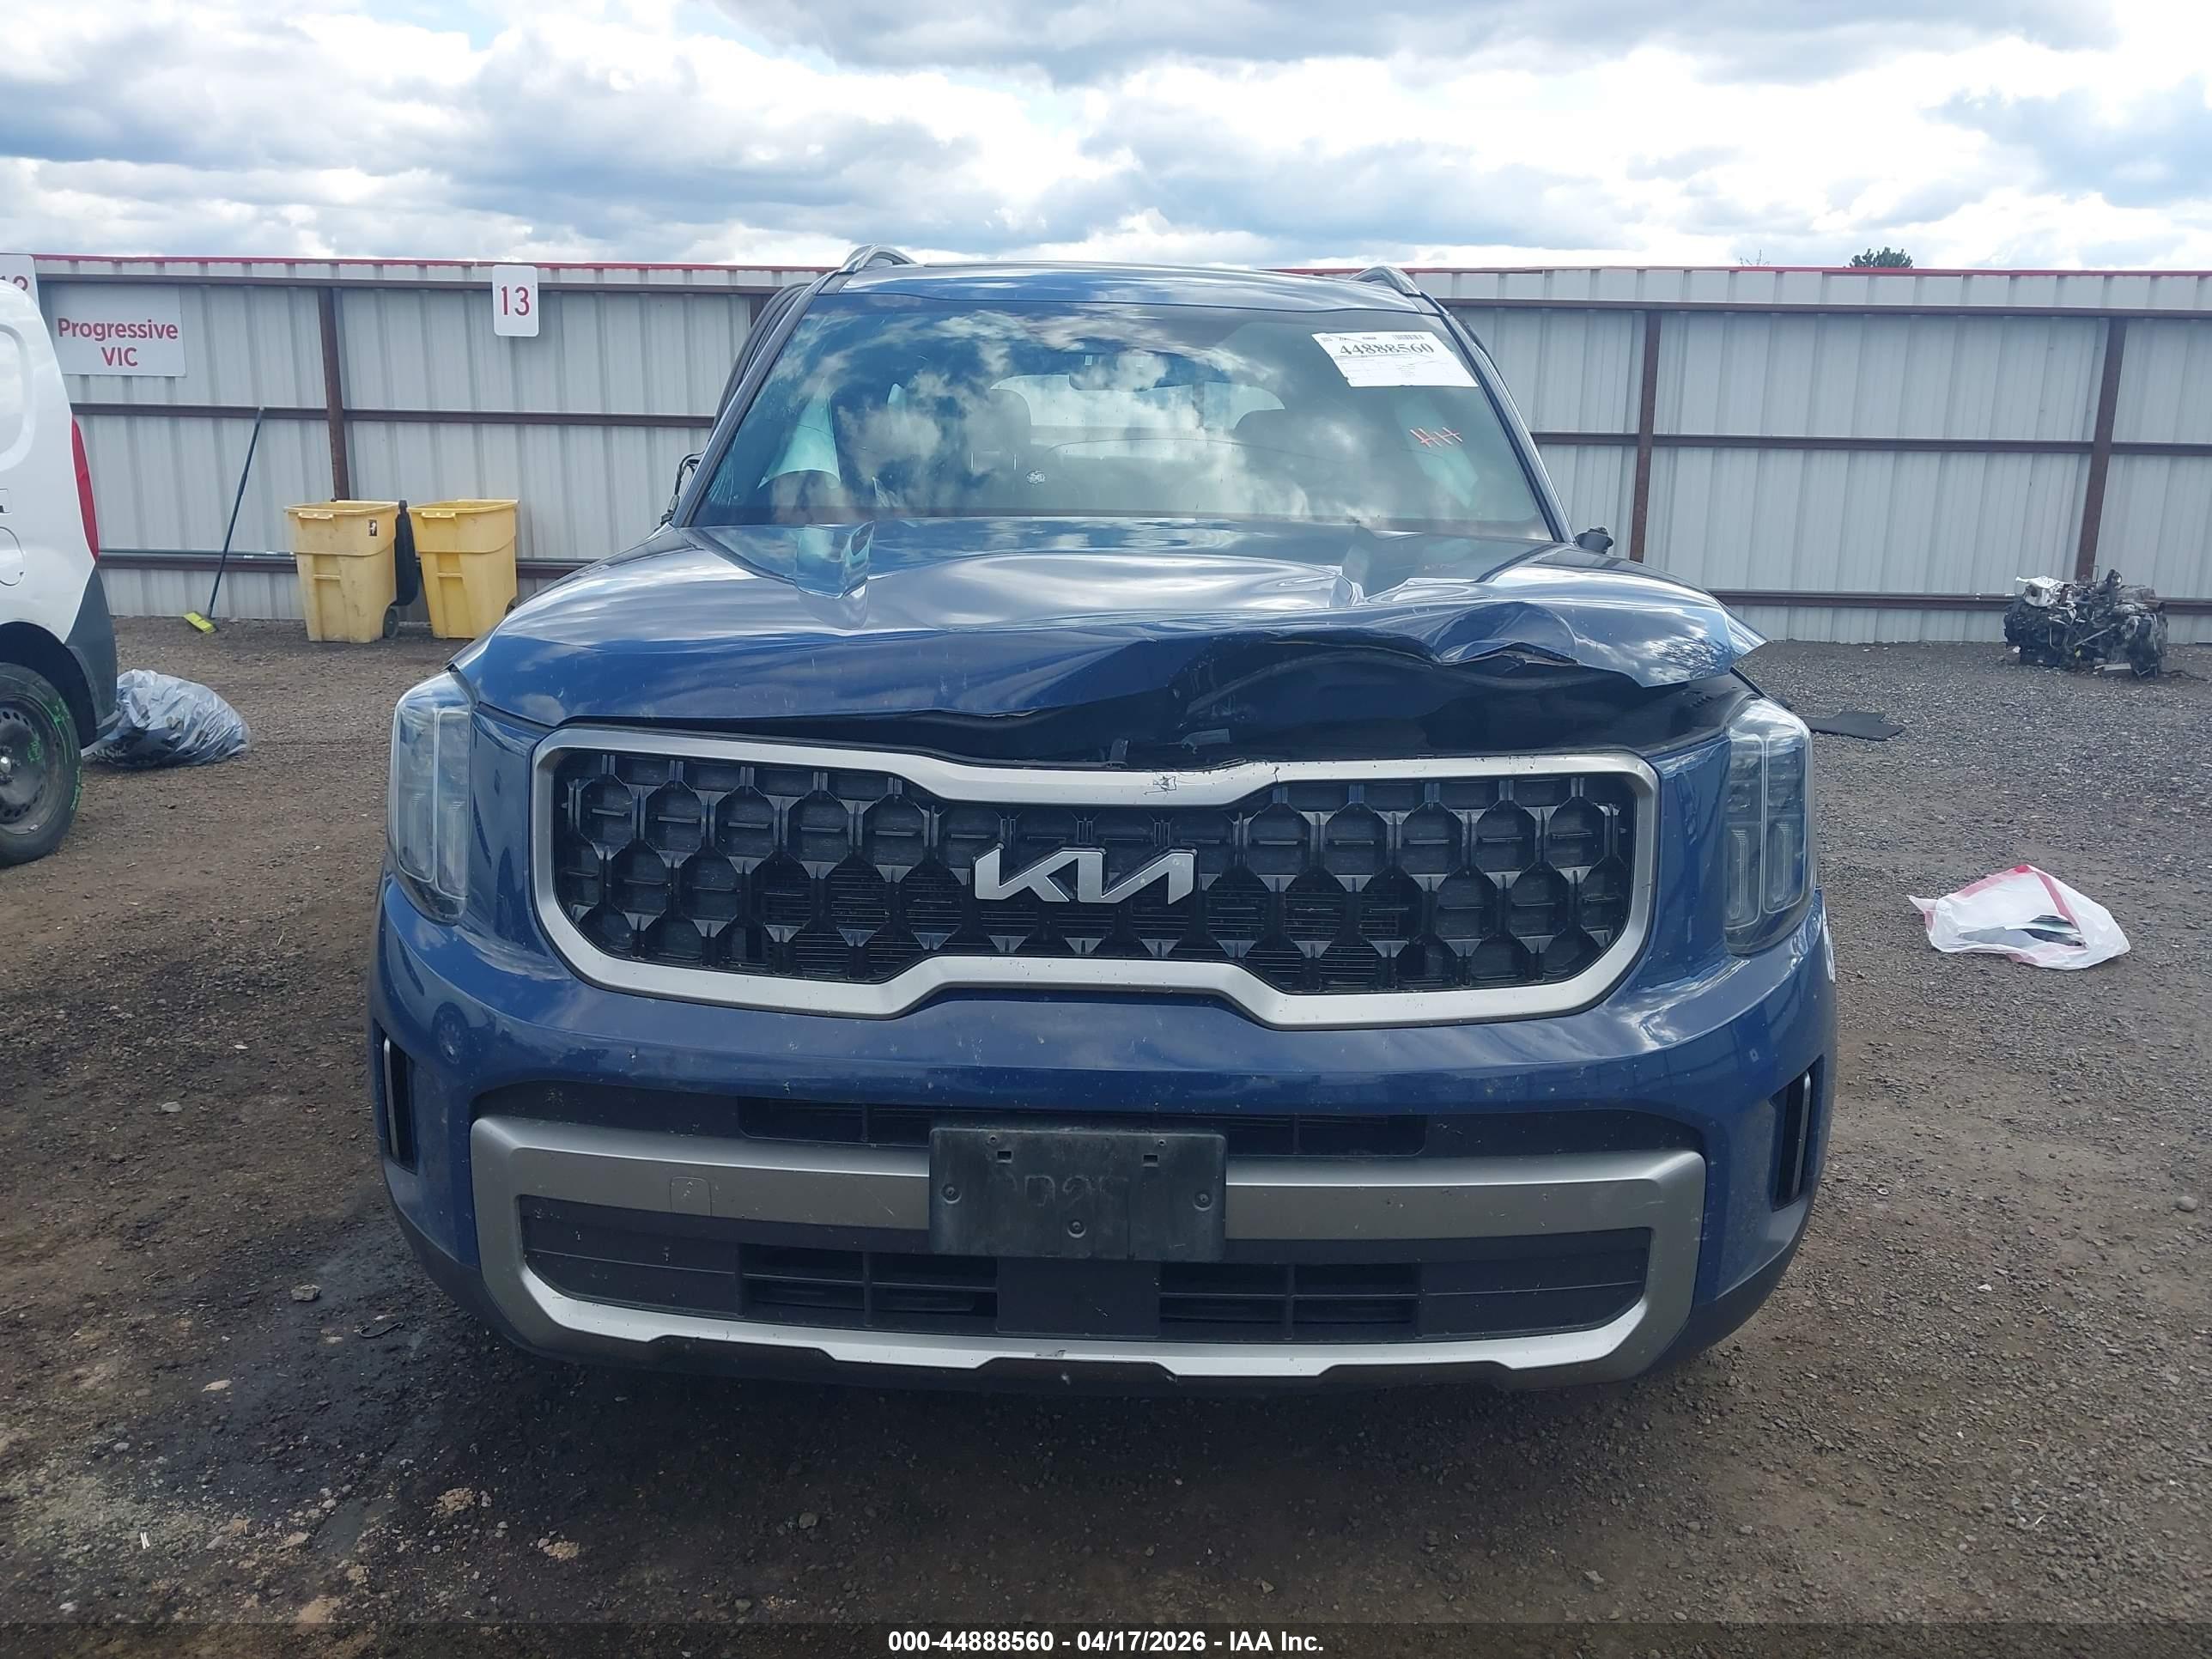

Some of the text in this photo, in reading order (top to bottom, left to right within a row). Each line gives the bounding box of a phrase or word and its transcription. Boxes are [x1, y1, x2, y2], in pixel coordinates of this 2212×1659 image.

[501, 286, 530, 316] 13
[58, 318, 179, 342] Progressive
[100, 347, 138, 367] VIC
[1340, 343, 1435, 355] 44888560
[974, 847, 1196, 906] KIA
